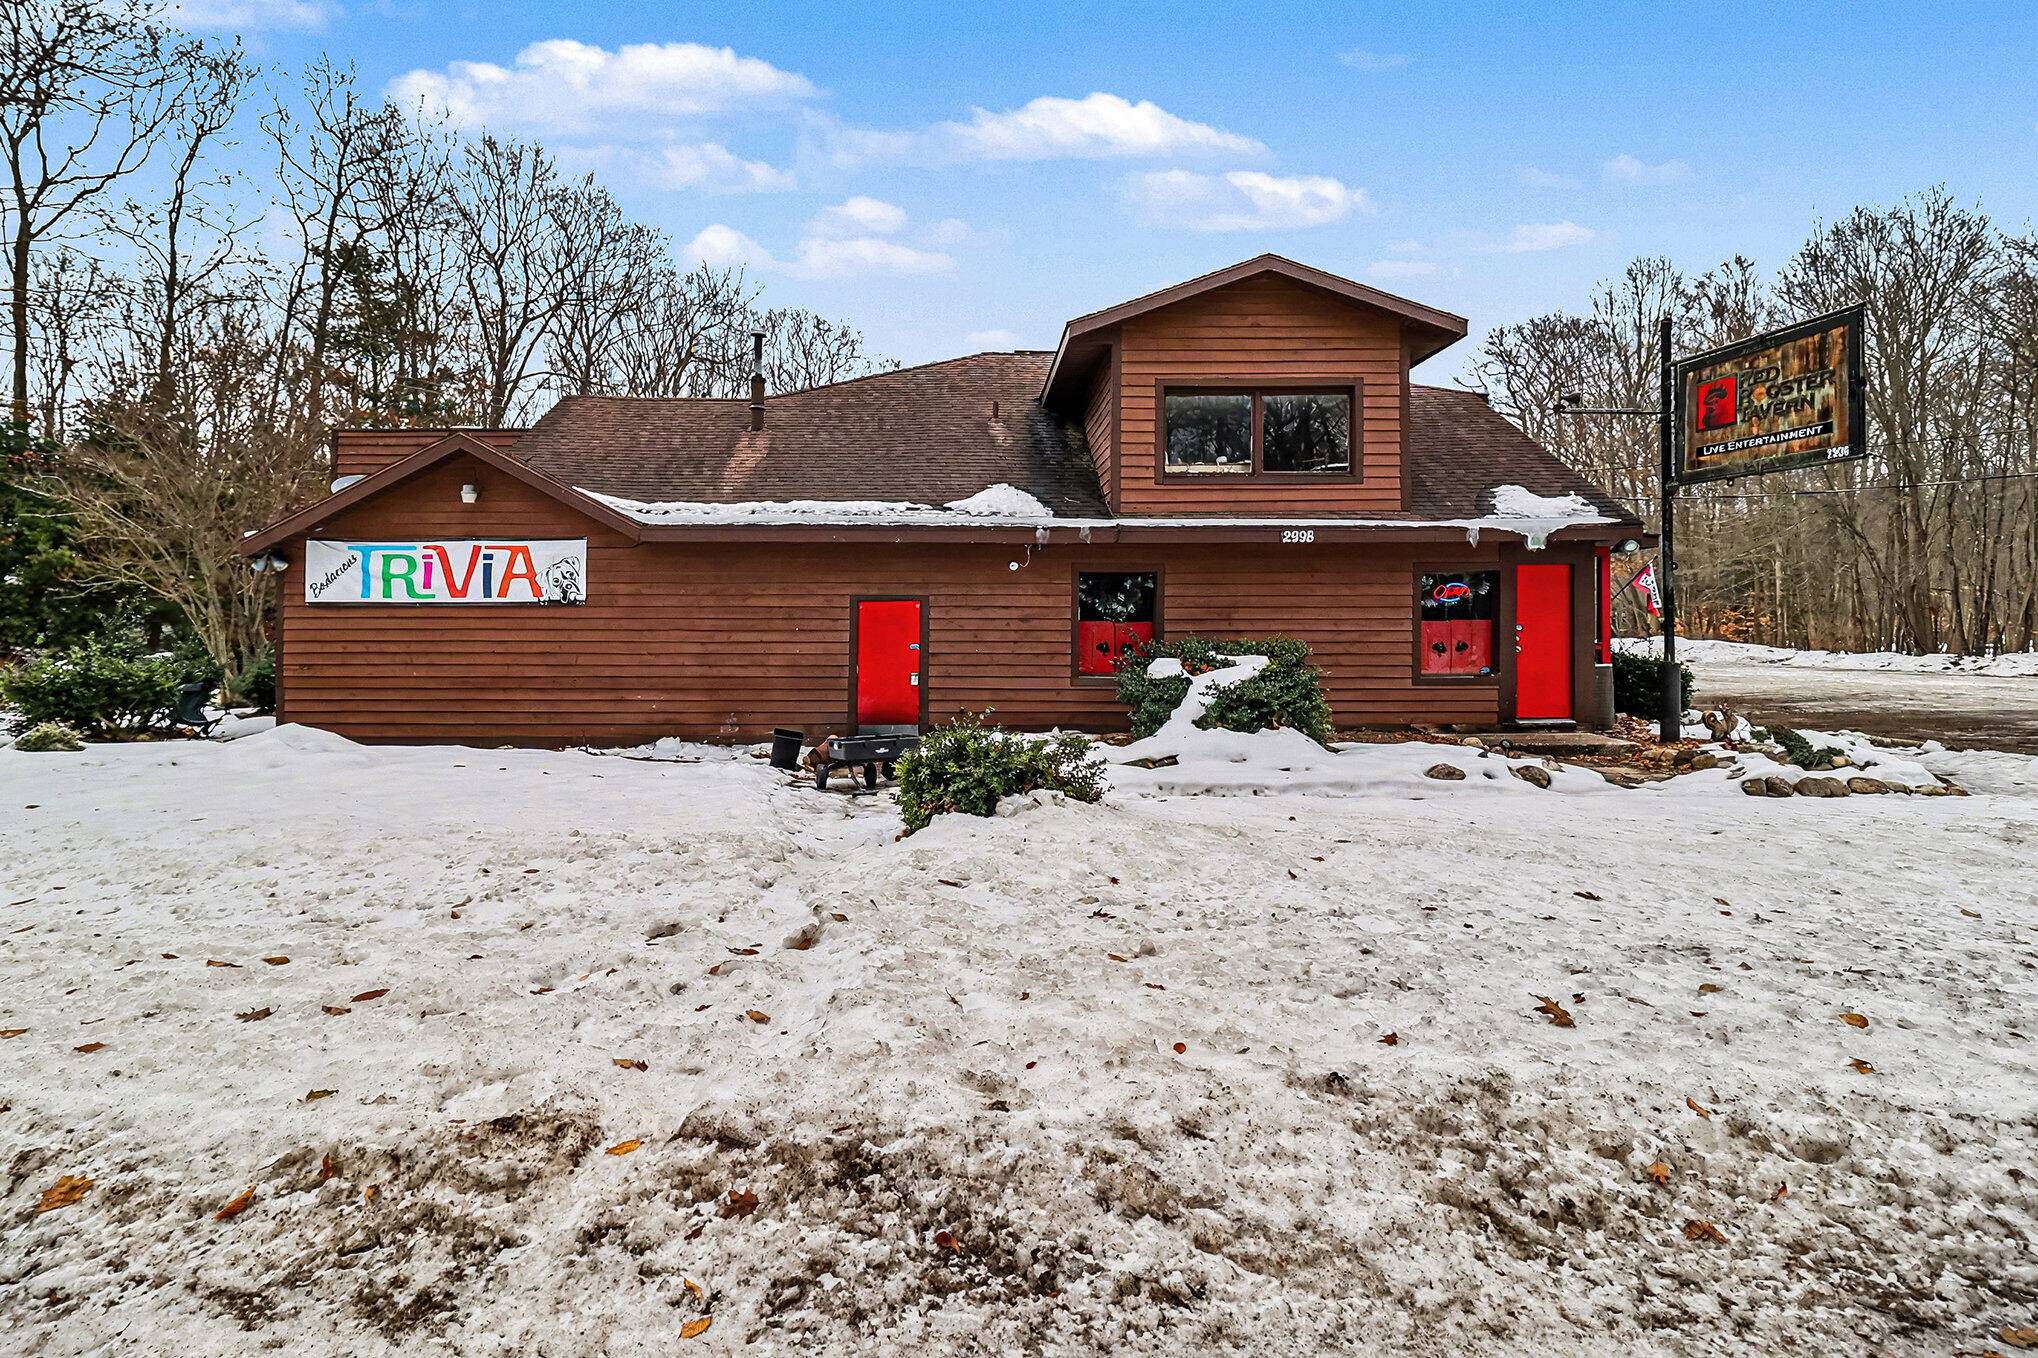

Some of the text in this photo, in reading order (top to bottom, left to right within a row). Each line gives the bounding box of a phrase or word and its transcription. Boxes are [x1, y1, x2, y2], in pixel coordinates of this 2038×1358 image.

[1740, 369, 1836, 408] ROSTER
[1703, 425, 1824, 456] LIVE ENTERTAINMENT
[1282, 530, 1315, 543] 2998
